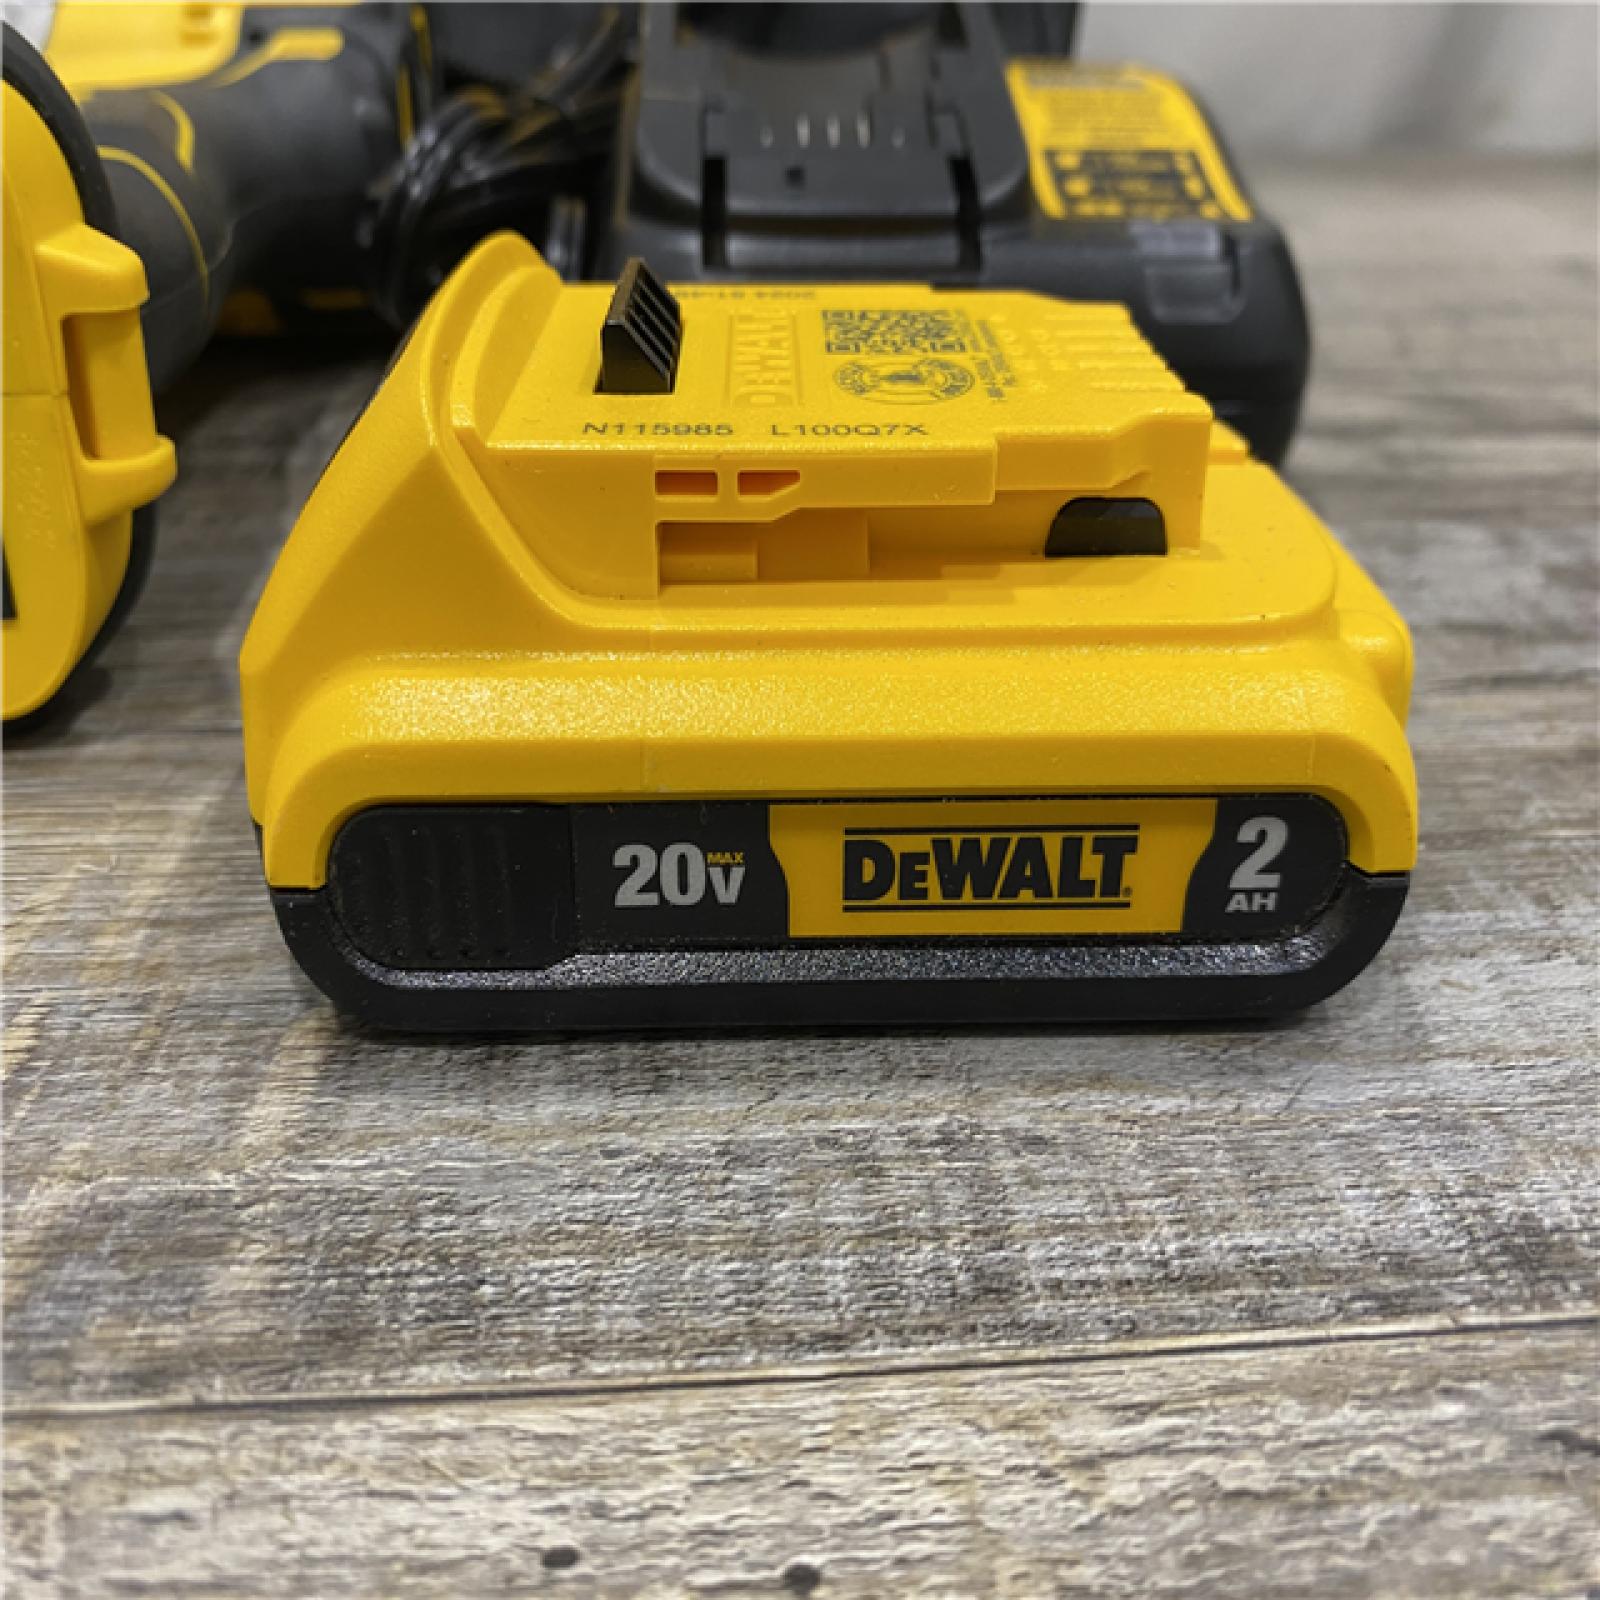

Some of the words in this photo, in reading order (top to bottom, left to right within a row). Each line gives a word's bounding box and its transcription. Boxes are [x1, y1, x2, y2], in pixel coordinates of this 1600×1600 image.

[770, 423, 929, 436] L100Q7X
[706, 852, 744, 864] MAX
[1228, 815, 1288, 889] 2
